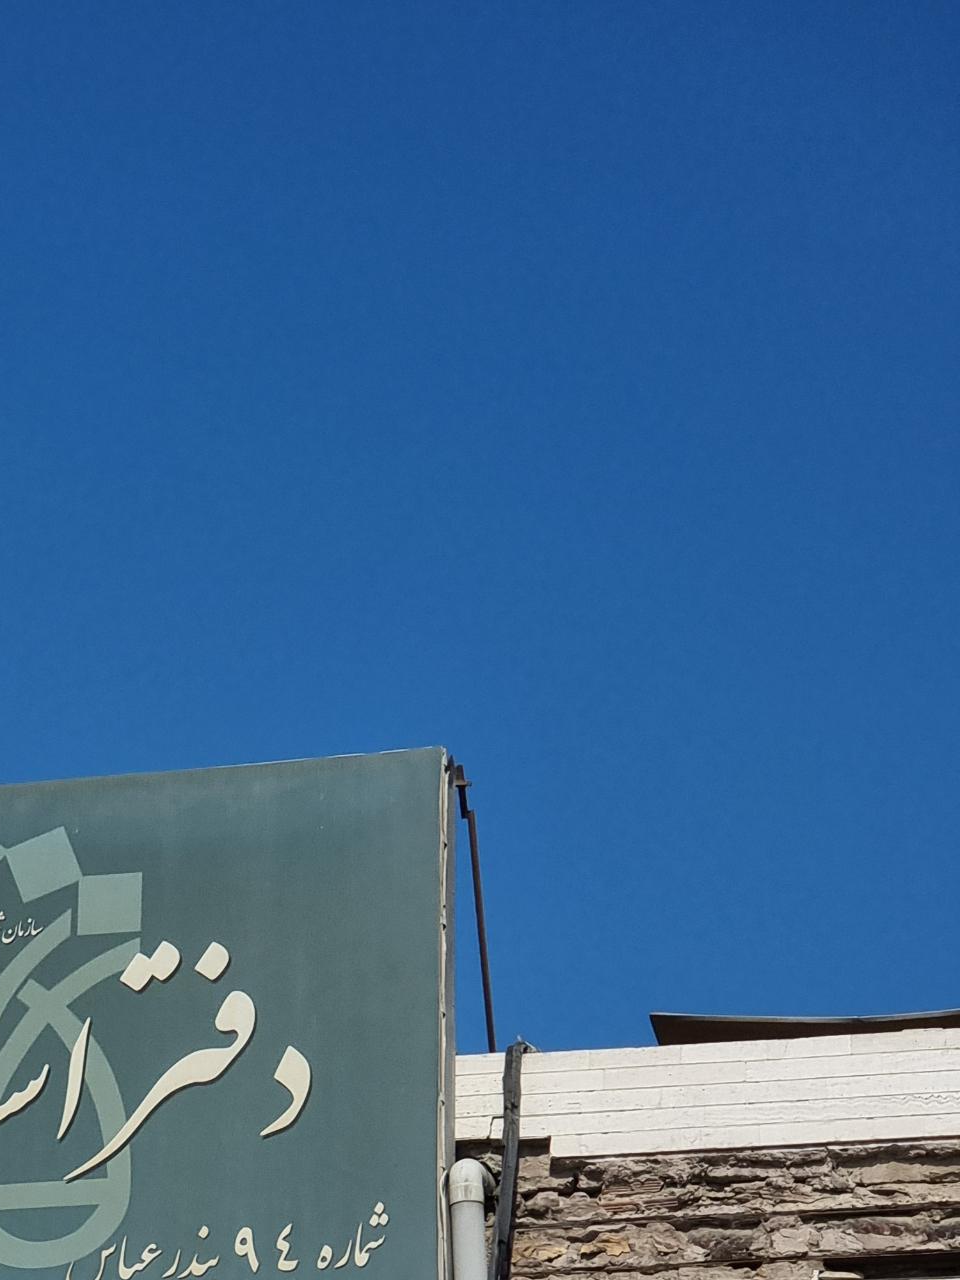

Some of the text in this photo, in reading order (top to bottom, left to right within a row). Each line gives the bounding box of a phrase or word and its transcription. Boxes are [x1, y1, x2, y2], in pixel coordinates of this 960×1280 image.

[1, 917, 44, 944] سازمان
[62, 940, 312, 1182] دفتر
[315, 1200, 390, 1270] شماره
